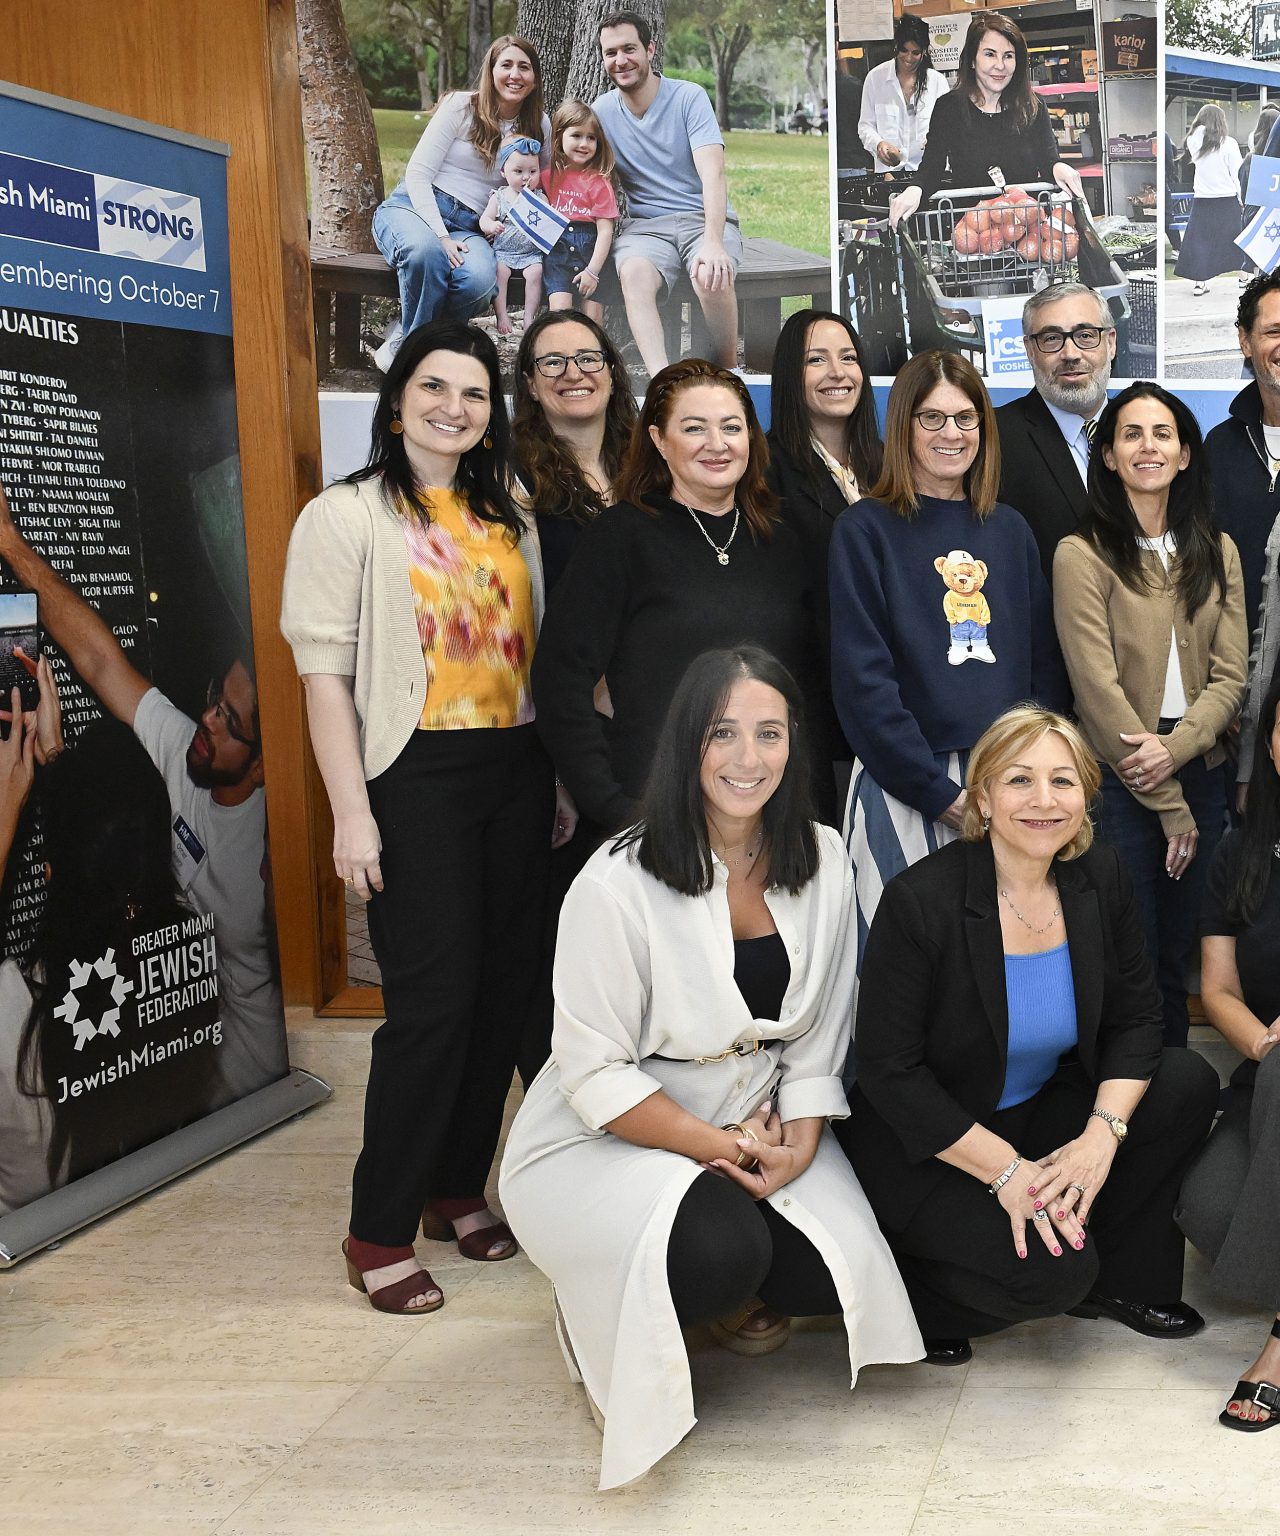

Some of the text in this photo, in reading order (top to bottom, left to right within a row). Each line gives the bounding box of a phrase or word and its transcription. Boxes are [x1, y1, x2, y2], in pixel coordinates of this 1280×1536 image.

[28, 183, 91, 222] Miami
[102, 200, 195, 241] STRONG
[119, 275, 206, 311] October
[210, 290, 220, 314] 7
[999, 362, 1033, 372] KOSHE
[20, 372, 68, 390] KONDEROV
[26, 388, 50, 400] TAEIR
[52, 392, 78, 404] DAVID
[10, 400, 25, 412] ZVI
[33, 403, 56, 415] RONY
[2, 414, 98, 434] TYBERG SAPIR BILMES
[10, 429, 42, 442] SHITRIT
[50, 433, 65, 444] TAL
[67, 435, 98, 448] DANIELI
[36, 446, 72, 459] SHLOMO
[74, 449, 105, 461] LIVMAN
[1, 458, 100, 474] FEBVRE MOR TRABELCI
[28, 474, 61, 486] ELIYAHU
[64, 476, 84, 486] ELIYA
[86, 478, 126, 489] TOLEDANO
[14, 488, 34, 498] LEVY
[42, 489, 74, 500] NAAMA
[76, 490, 110, 502] MOALEM
[28, 503, 45, 513] BEN
[48, 503, 88, 514] BENZIYON
[90, 505, 114, 515] HASID
[20, 517, 121, 528] ITSHAC LEVY SIGAL ITAH
[22, 532, 104, 541] SARFATY NIV RAVIV
[48, 546, 75, 555] BARDA
[82, 546, 105, 556] ELDAD
[108, 546, 131, 555] ANGEL
[70, 573, 87, 583] DAN
[82, 585, 134, 596] IGOR KURTSER
[112, 624, 138, 635] GALON
[132, 912, 215, 956] GREATER MIAMI
[135, 936, 218, 1000] JEWISH
[138, 975, 218, 1028] FEDERATION
[57, 1020, 222, 1104] JewishMiami.org
